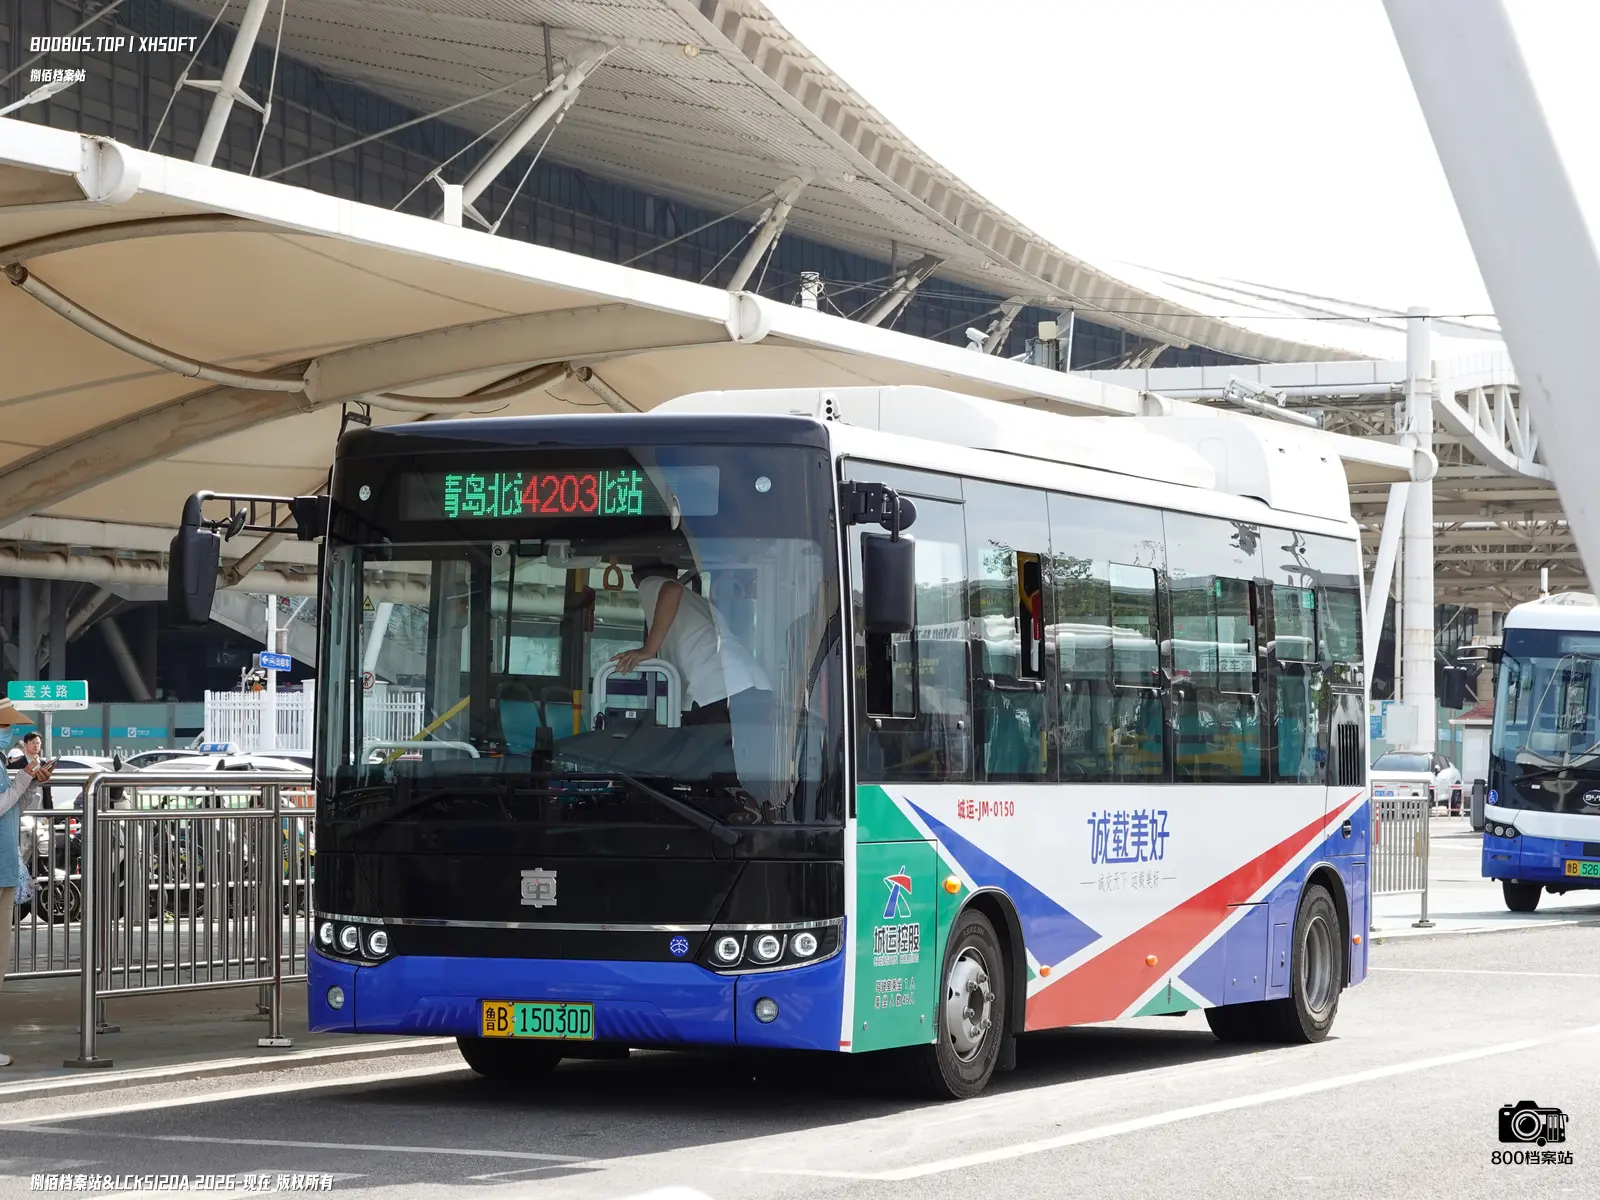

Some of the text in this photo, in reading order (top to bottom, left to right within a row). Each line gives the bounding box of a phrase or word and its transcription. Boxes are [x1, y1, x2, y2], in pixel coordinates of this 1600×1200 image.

[521, 474, 598, 514] 4203
[23, 684, 68, 699] 壶关路
[957, 799, 1015, 821] 城运-JM-0150
[1087, 809, 1170, 864] 诚载美好
[1582, 863, 1600, 875] 526
[874, 923, 920, 955] 城运控股
[485, 1006, 591, 1034] 鲁B 15030D
